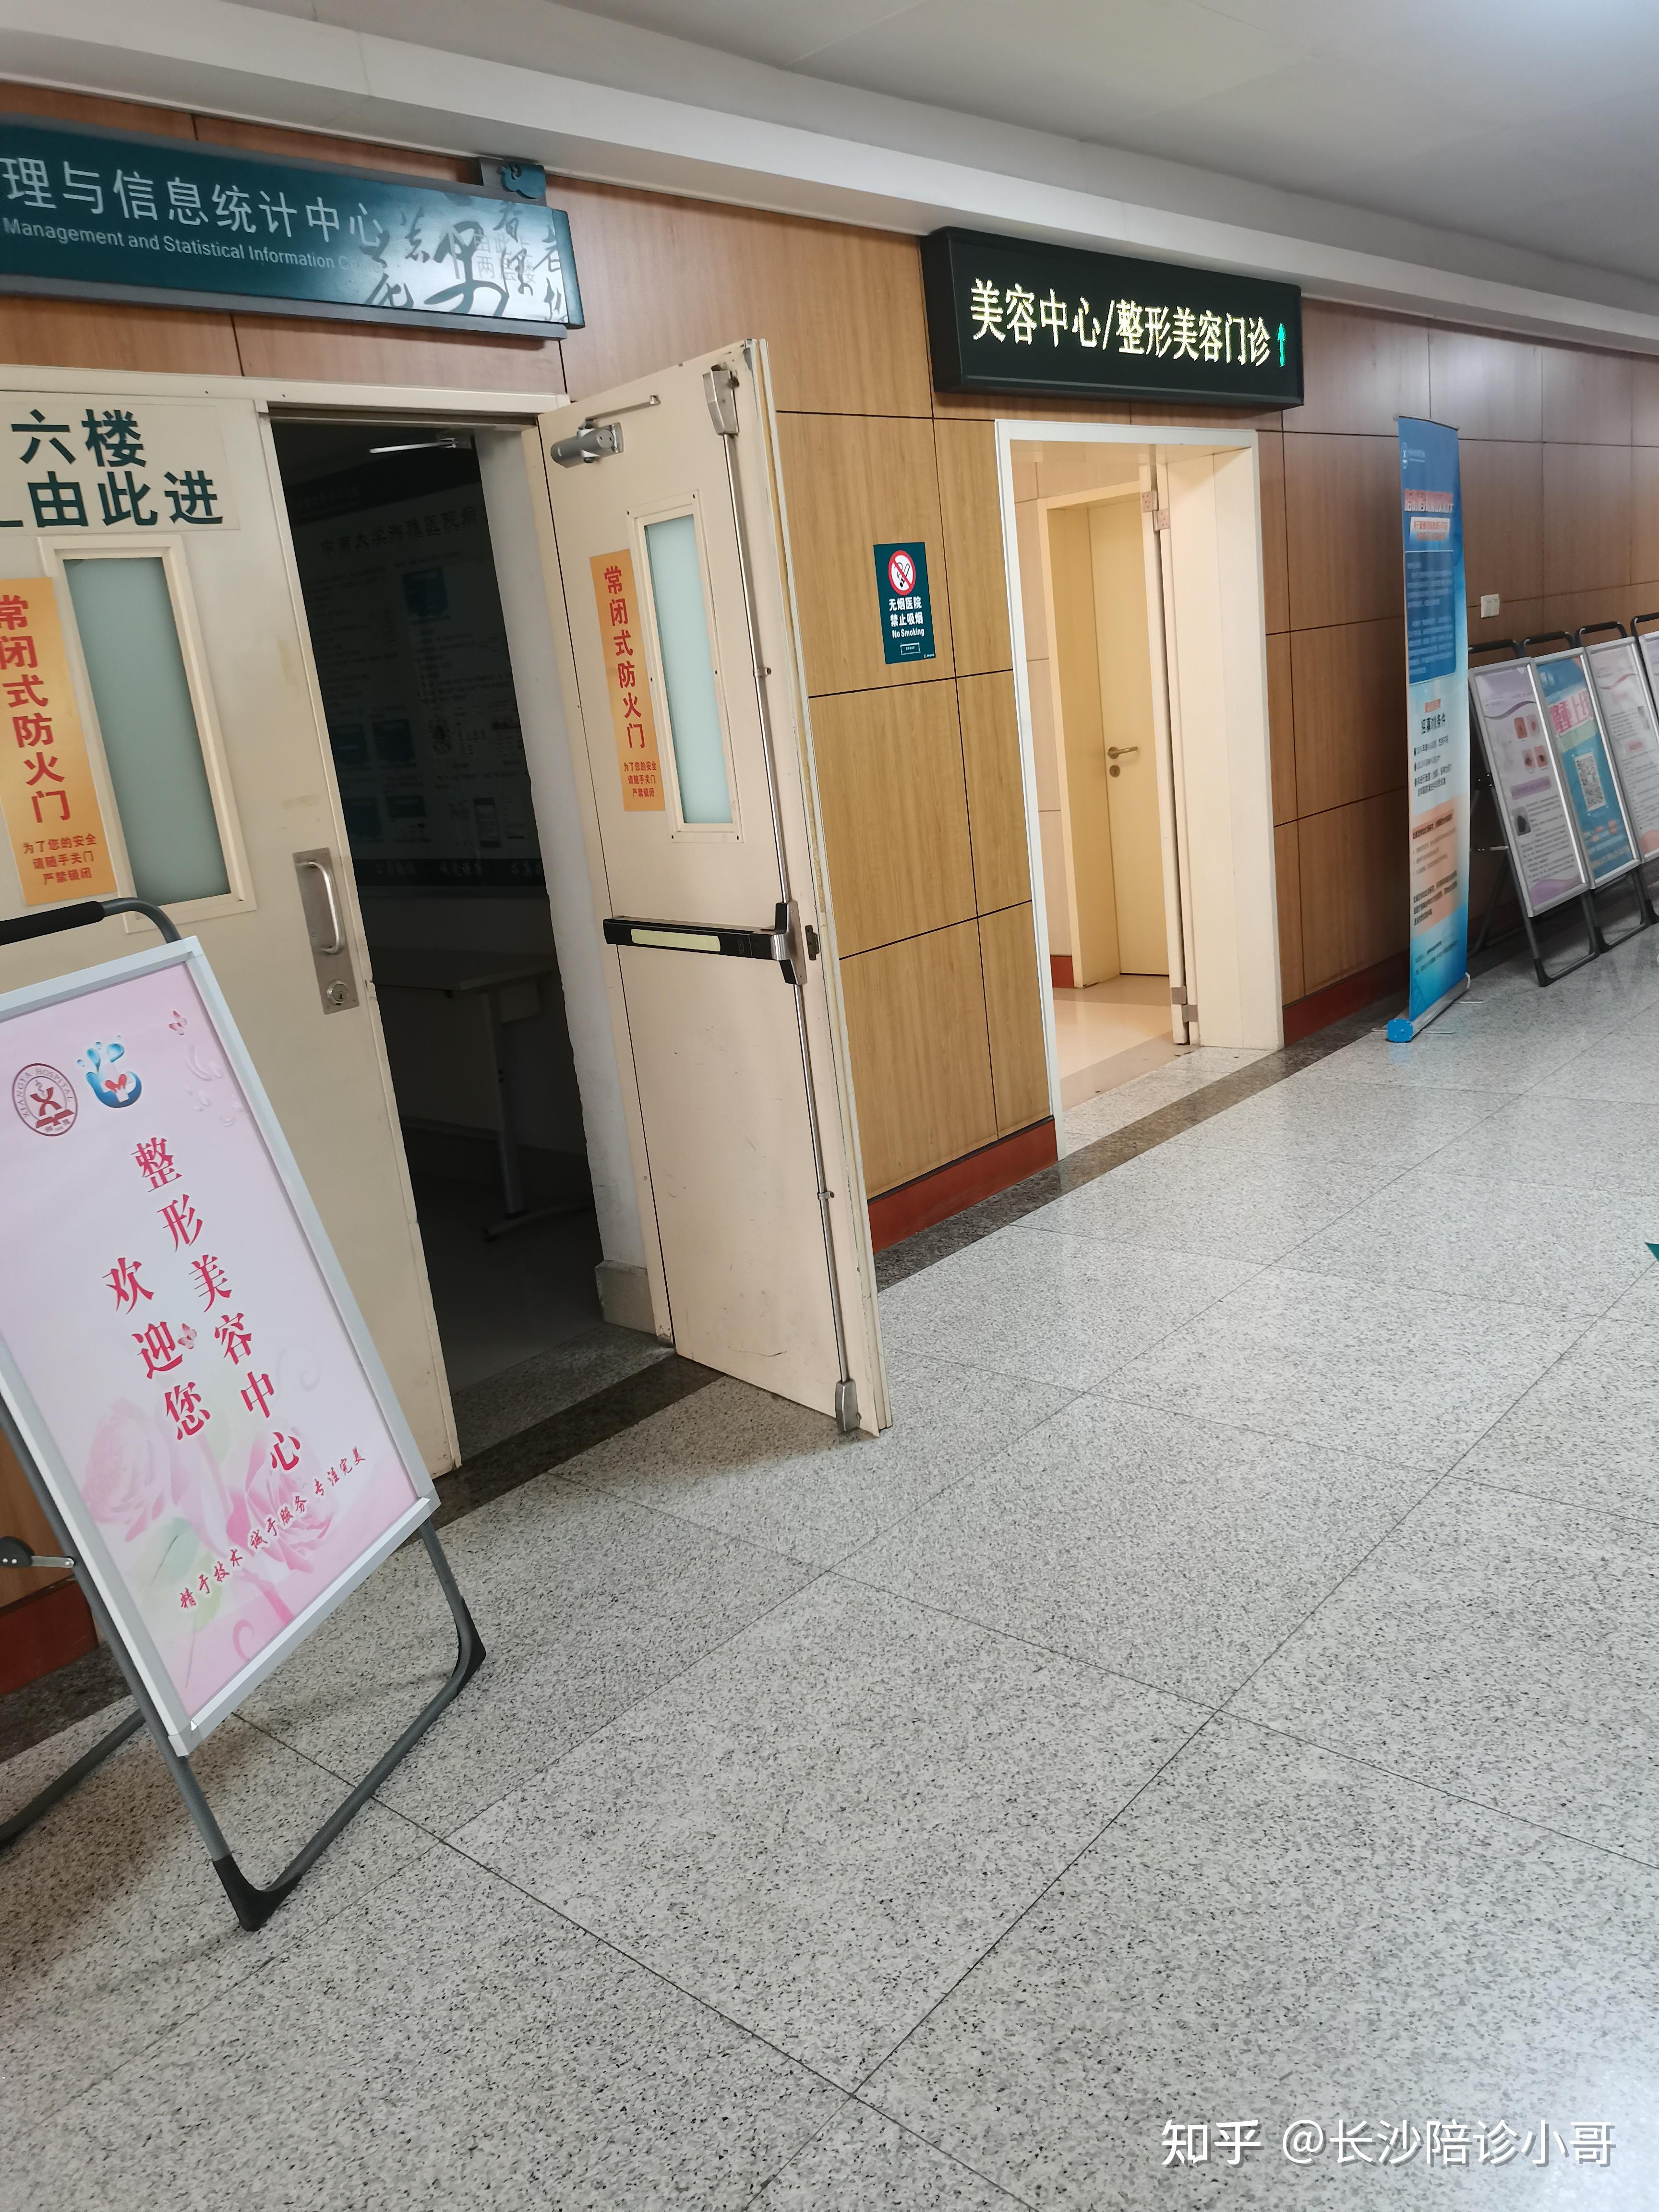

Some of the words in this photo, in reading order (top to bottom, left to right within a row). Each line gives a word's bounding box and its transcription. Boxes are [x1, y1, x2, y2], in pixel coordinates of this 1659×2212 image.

[0, 157, 384, 247] 理与信息统计中心
[3, 217, 125, 247] Management
[128, 235, 160, 251] and
[164, 236, 244, 260] Statistical
[249, 245, 335, 269] Information
[970, 277, 1272, 367] 美容中心/整形美容门诊
[11, 409, 146, 468] 六楼
[0, 470, 223, 528] 由此进
[889, 597, 922, 611] 无烟医院
[890, 612, 924, 627] 禁止吸烟
[604, 565, 645, 749] 常闭式防火门
[892, 629, 901, 639] No
[901, 628, 925, 637] Smoking
[0, 595, 71, 823] 常闭式防火门
[624, 761, 657, 771] 为了您的安全
[23, 833, 97, 855] 为了您的安全
[33, 851, 94, 869] 请随手关门
[131, 1137, 301, 1471] 整形美容中心
[102, 1257, 211, 1441] 欢迎您
